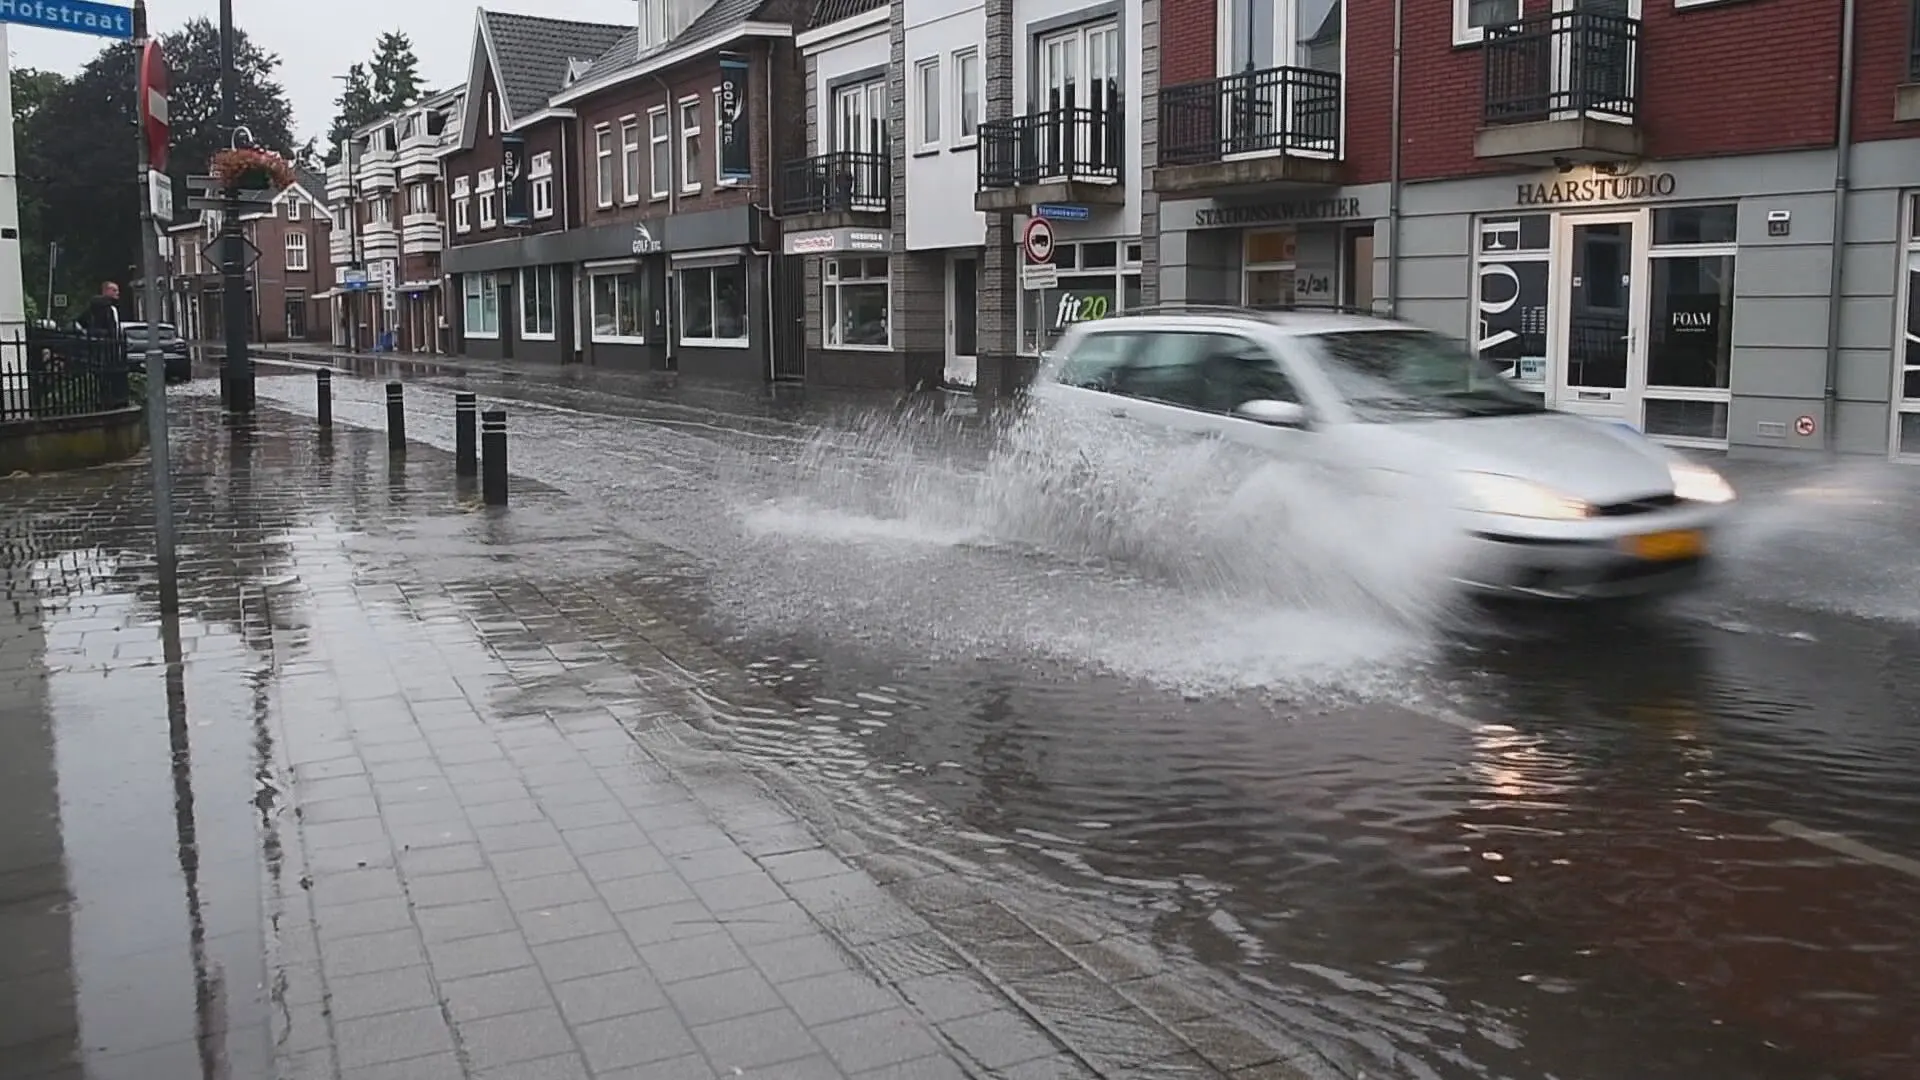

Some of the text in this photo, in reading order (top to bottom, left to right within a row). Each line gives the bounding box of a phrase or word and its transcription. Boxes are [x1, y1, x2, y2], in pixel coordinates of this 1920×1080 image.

[0, 0, 124, 31] Hofstraat
[723, 81, 734, 116] GOLF
[505, 151, 514, 176] GOLF
[1516, 173, 1676, 205] HAARSTUDIO
[1194, 197, 1360, 226] STATIONSKWARTIER
[632, 239, 648, 253] GOLF
[1055, 292, 1108, 328] fit20
[1672, 311, 1711, 326] FOAM
